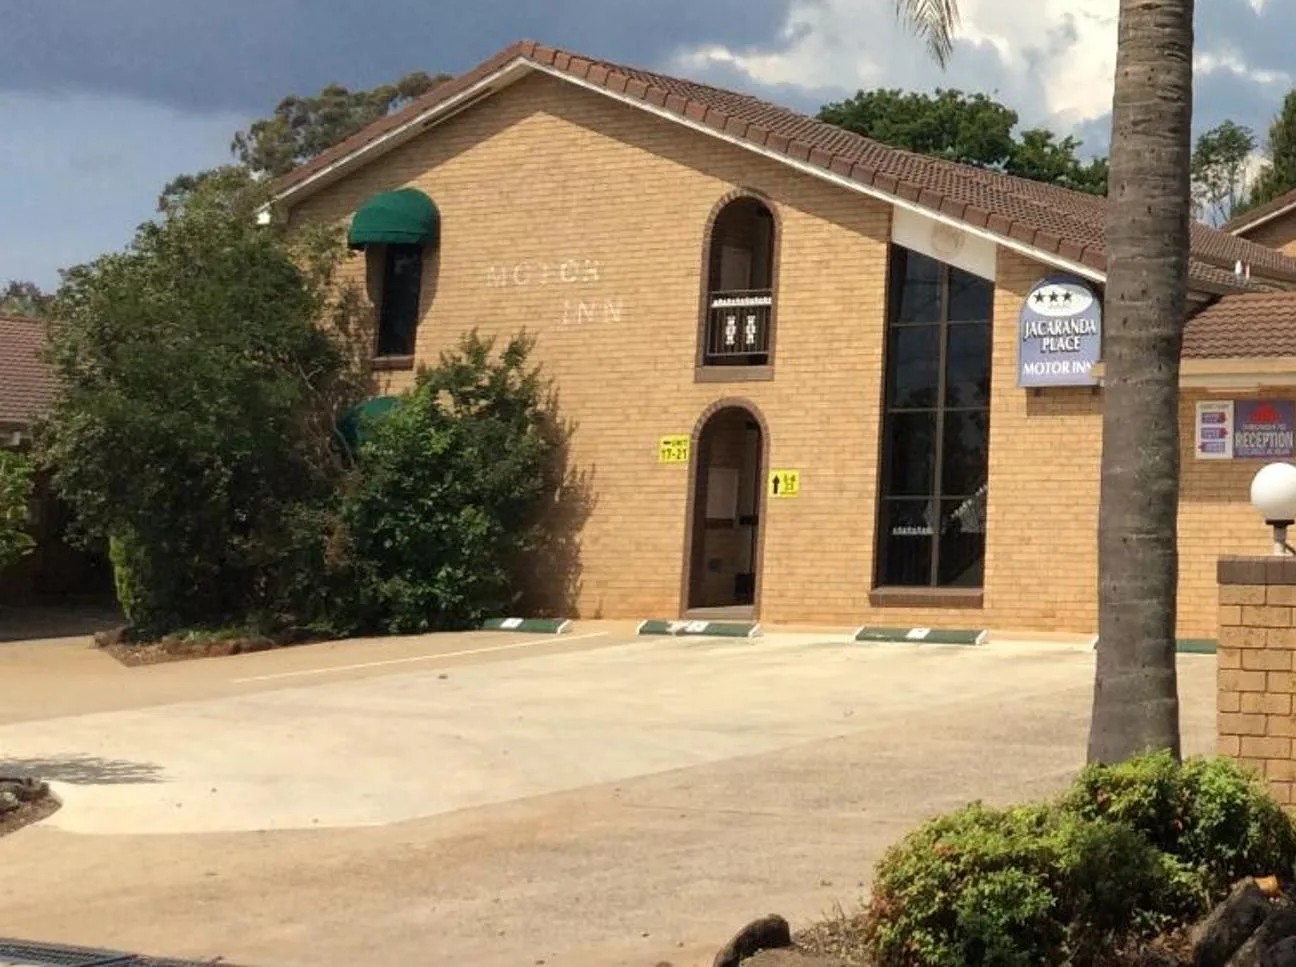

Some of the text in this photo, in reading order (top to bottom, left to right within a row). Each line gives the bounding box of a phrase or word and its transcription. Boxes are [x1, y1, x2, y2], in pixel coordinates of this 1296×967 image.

[562, 297, 623, 325] INN
[1023, 318, 1097, 340] JACARANDA
[1041, 335, 1081, 353] PLACE
[1022, 360, 1069, 376] MOTOR
[1234, 431, 1294, 448] RECEPTION
